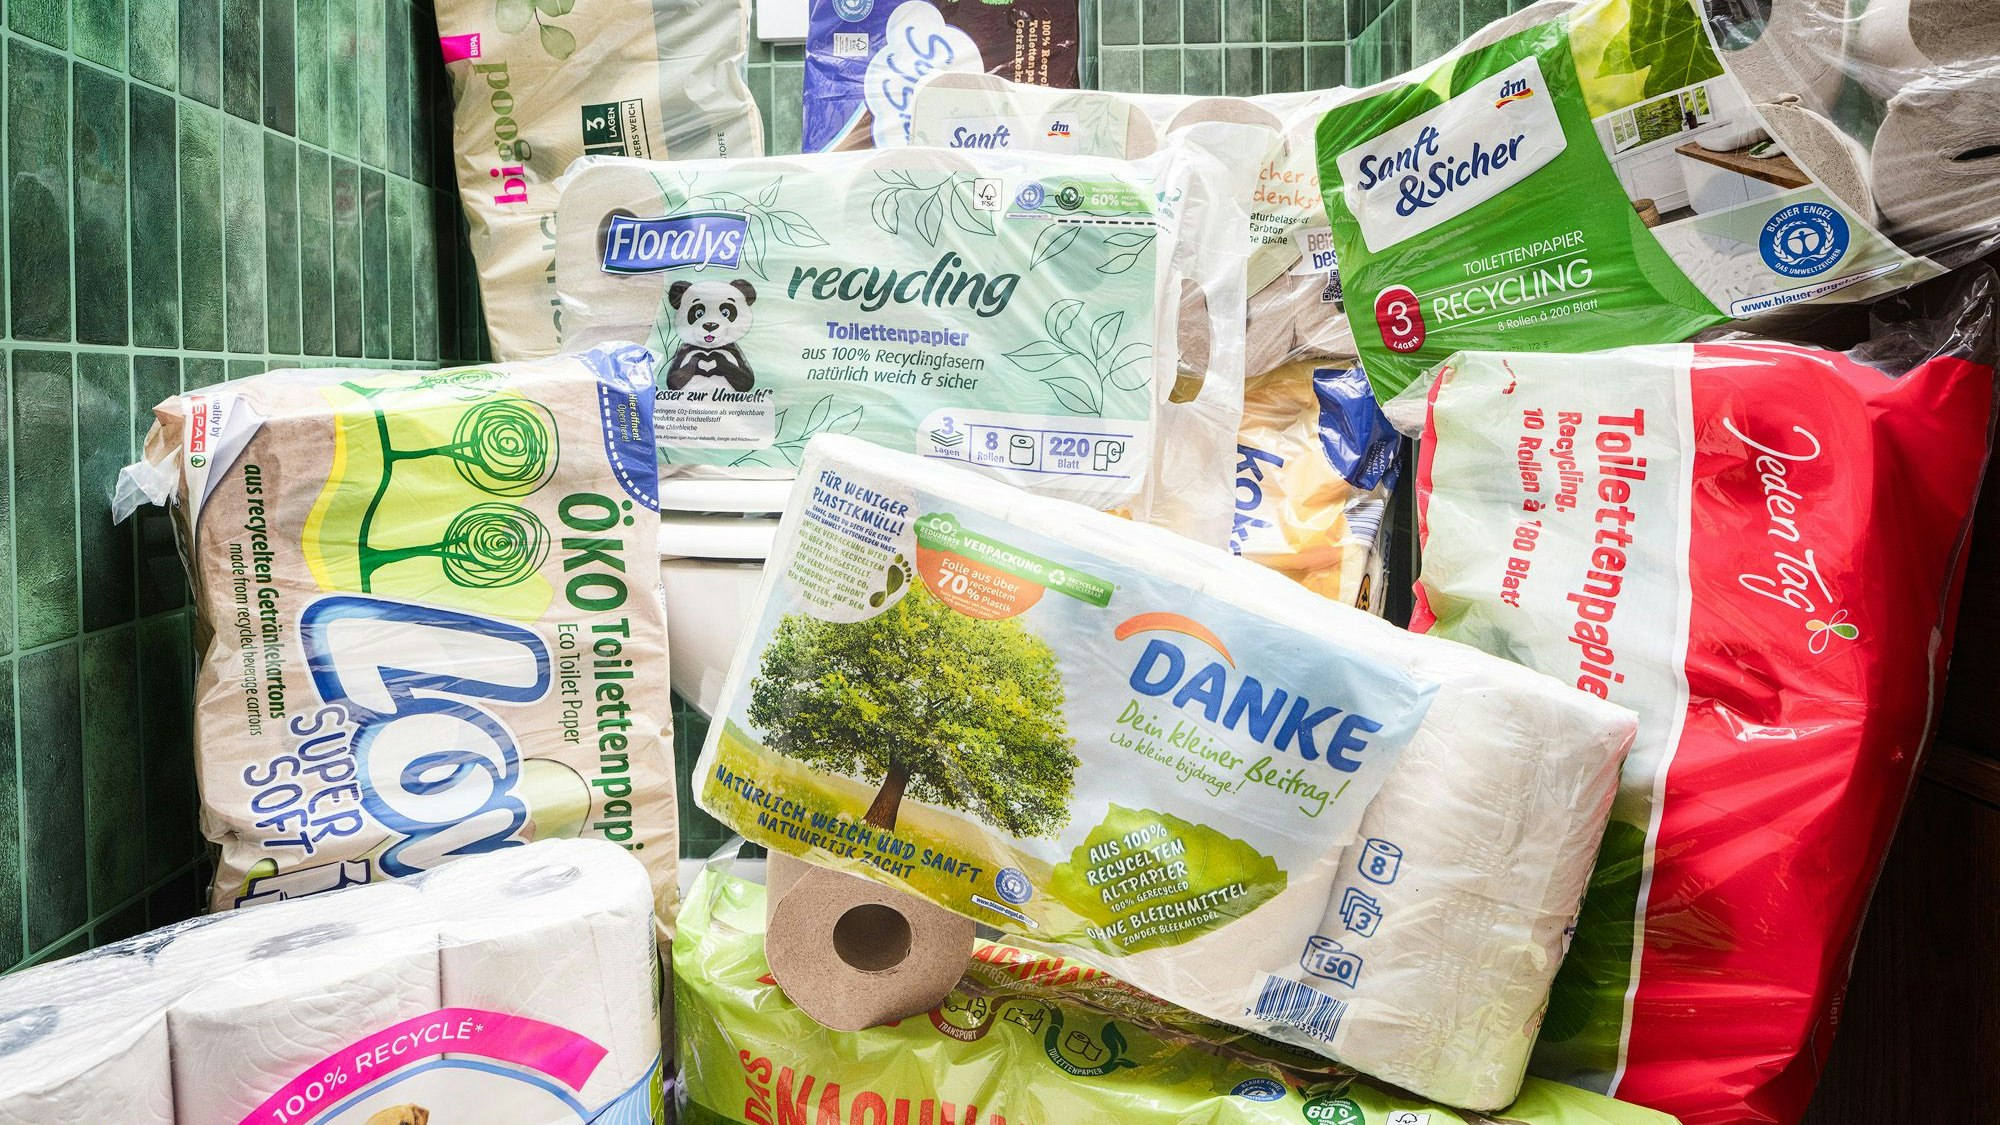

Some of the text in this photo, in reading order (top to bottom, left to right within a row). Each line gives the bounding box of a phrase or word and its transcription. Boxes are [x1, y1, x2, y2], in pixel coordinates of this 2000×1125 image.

[470, 36, 479, 57] BIPA
[1042, 20, 1051, 47] 100%
[1500, 78, 1527, 98] dm
[586, 117, 606, 131] 3
[607, 107, 617, 138] LAGEN
[628, 103, 637, 133] WEICH
[1052, 120, 1069, 133] dm
[950, 125, 1010, 150] Sanft
[1358, 126, 1440, 191] Sanft
[1091, 194, 1120, 207] 60%
[1249, 223, 1284, 235] Farbton
[1767, 204, 1834, 233] BLAUER ENGEL
[610, 223, 739, 272] Floralys
[1463, 229, 1585, 277] TOILETTENPAPIER
[1775, 248, 1841, 275] DAS UMWELTZEICHEN
[788, 252, 1020, 318] recycling
[1432, 258, 1593, 323] RECYCLING
[1387, 300, 1412, 337] 3
[1498, 298, 1599, 332] 8 Rollen à 200 Blatt
[827, 322, 969, 348] Toilettenpapier
[1393, 335, 1420, 351] LAGEN
[801, 347, 985, 371] aus 100% Recyclingfasern
[807, 366, 979, 390] natürlich weich & sicher
[687, 391, 708, 402] zur
[193, 404, 205, 452] SPAR
[210, 427, 221, 438] by
[617, 403, 631, 443] Open here!
[628, 393, 642, 441] Hier öffnen!
[943, 416, 954, 435] 3
[1522, 408, 1545, 432] 10
[934, 446, 960, 458] Lagen
[977, 451, 1004, 464] Rollen
[985, 432, 999, 451] 8
[1049, 437, 1090, 458] 220
[1057, 458, 1080, 470] Blatt
[1517, 435, 1543, 494] Rollen
[1555, 410, 1583, 513] Recycling,
[820, 470, 909, 519] FÜR WENIGER
[812, 486, 905, 537] PLASTIKMÜLL!
[827, 512, 841, 523] DASS
[841, 518, 849, 526] DU
[849, 521, 864, 533] DICH
[877, 532, 892, 543] EINE
[1723, 416, 1835, 614] Jeden Tag
[557, 492, 635, 612] ÖKO
[841, 527, 879, 548] ENTSCHIEDEN
[879, 543, 897, 555] HAST.
[1514, 519, 1542, 554] 180
[840, 549, 885, 572] RECYCELTEM
[867, 546, 888, 561] WIRD
[963, 536, 1044, 575] VERPACKUNG
[941, 557, 970, 575] Folie
[971, 570, 992, 583] aus
[992, 573, 1020, 594] über
[968, 579, 1016, 603] recyceltem
[1501, 556, 1531, 609] Blatt
[244, 464, 287, 720] aus recycelten Getränkekartons
[832, 593, 848, 604] AUF
[848, 598, 866, 612] DEM
[981, 594, 1013, 614] Plastik
[229, 543, 263, 736] made from recycled beverage cartons
[557, 623, 583, 745] Eco Toilet Paper
[1129, 638, 1384, 773] DANKE
[1116, 698, 1352, 819] Dein kleiner Beitrag!
[1135, 738, 1246, 797] kleine bijdrage!
[290, 705, 365, 849] SUPER
[243, 755, 314, 857] SOFT
[715, 764, 983, 884] NATÜRLICH WEICH UND SANFT
[756, 810, 916, 880] NATUURLIJK ZACHT
[1089, 823, 1169, 864] AUS 100%
[1086, 837, 1186, 888] RECYCELTEM
[1370, 855, 1387, 876] 8
[1100, 860, 1189, 905] ALTPAPIER
[1110, 881, 1190, 914] 100% GERECYCLED
[1087, 881, 1249, 942] OHNE BLEICHMITTEL
[1355, 911, 1372, 931] 3
[1122, 910, 1220, 947] ZONDER BLEEKMIDDEL
[1313, 953, 1354, 981] 150
[938, 1021, 977, 1041] TRANSPORT
[1294, 1020, 1330, 1044] 035917
[1048, 1047, 1104, 1076] TOILETTENPAPIER
[272, 1066, 349, 1125] 100%
[740, 1050, 774, 1125] DAS
